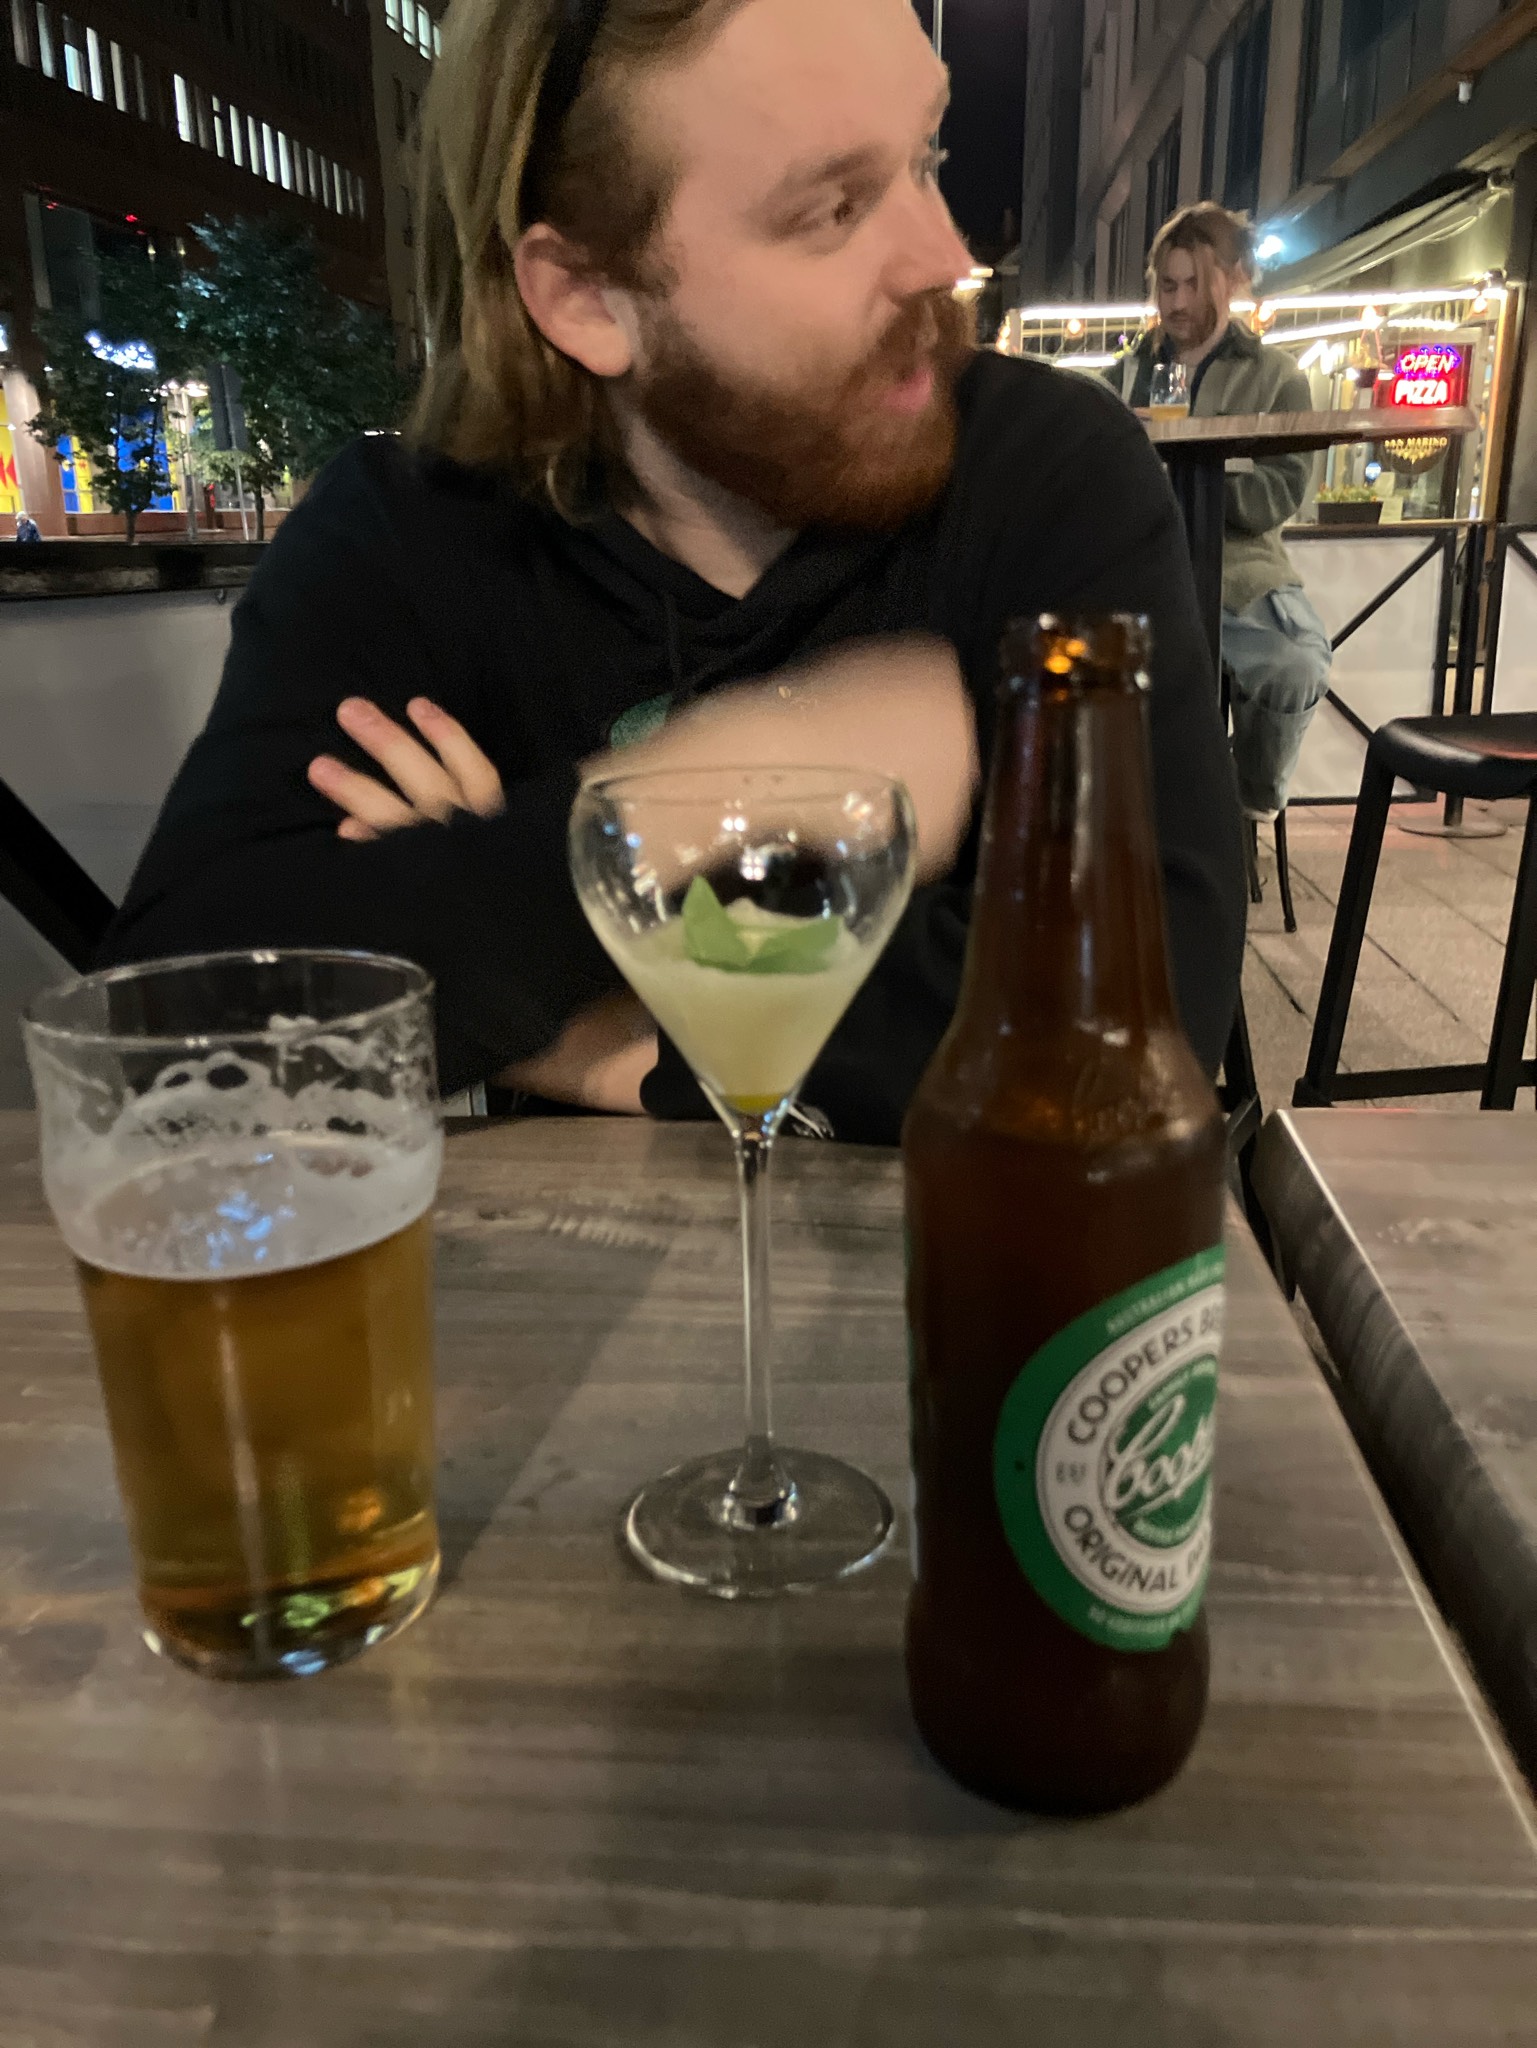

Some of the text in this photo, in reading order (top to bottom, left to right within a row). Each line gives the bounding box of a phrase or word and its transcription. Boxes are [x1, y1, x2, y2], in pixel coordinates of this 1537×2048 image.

[1401, 353, 1452, 373] OPEN
[1395, 379, 1448, 404] PIZZA
[1067, 1314, 1193, 1444] COOPERS
[1064, 1505, 1178, 1592] ORIGINAL
